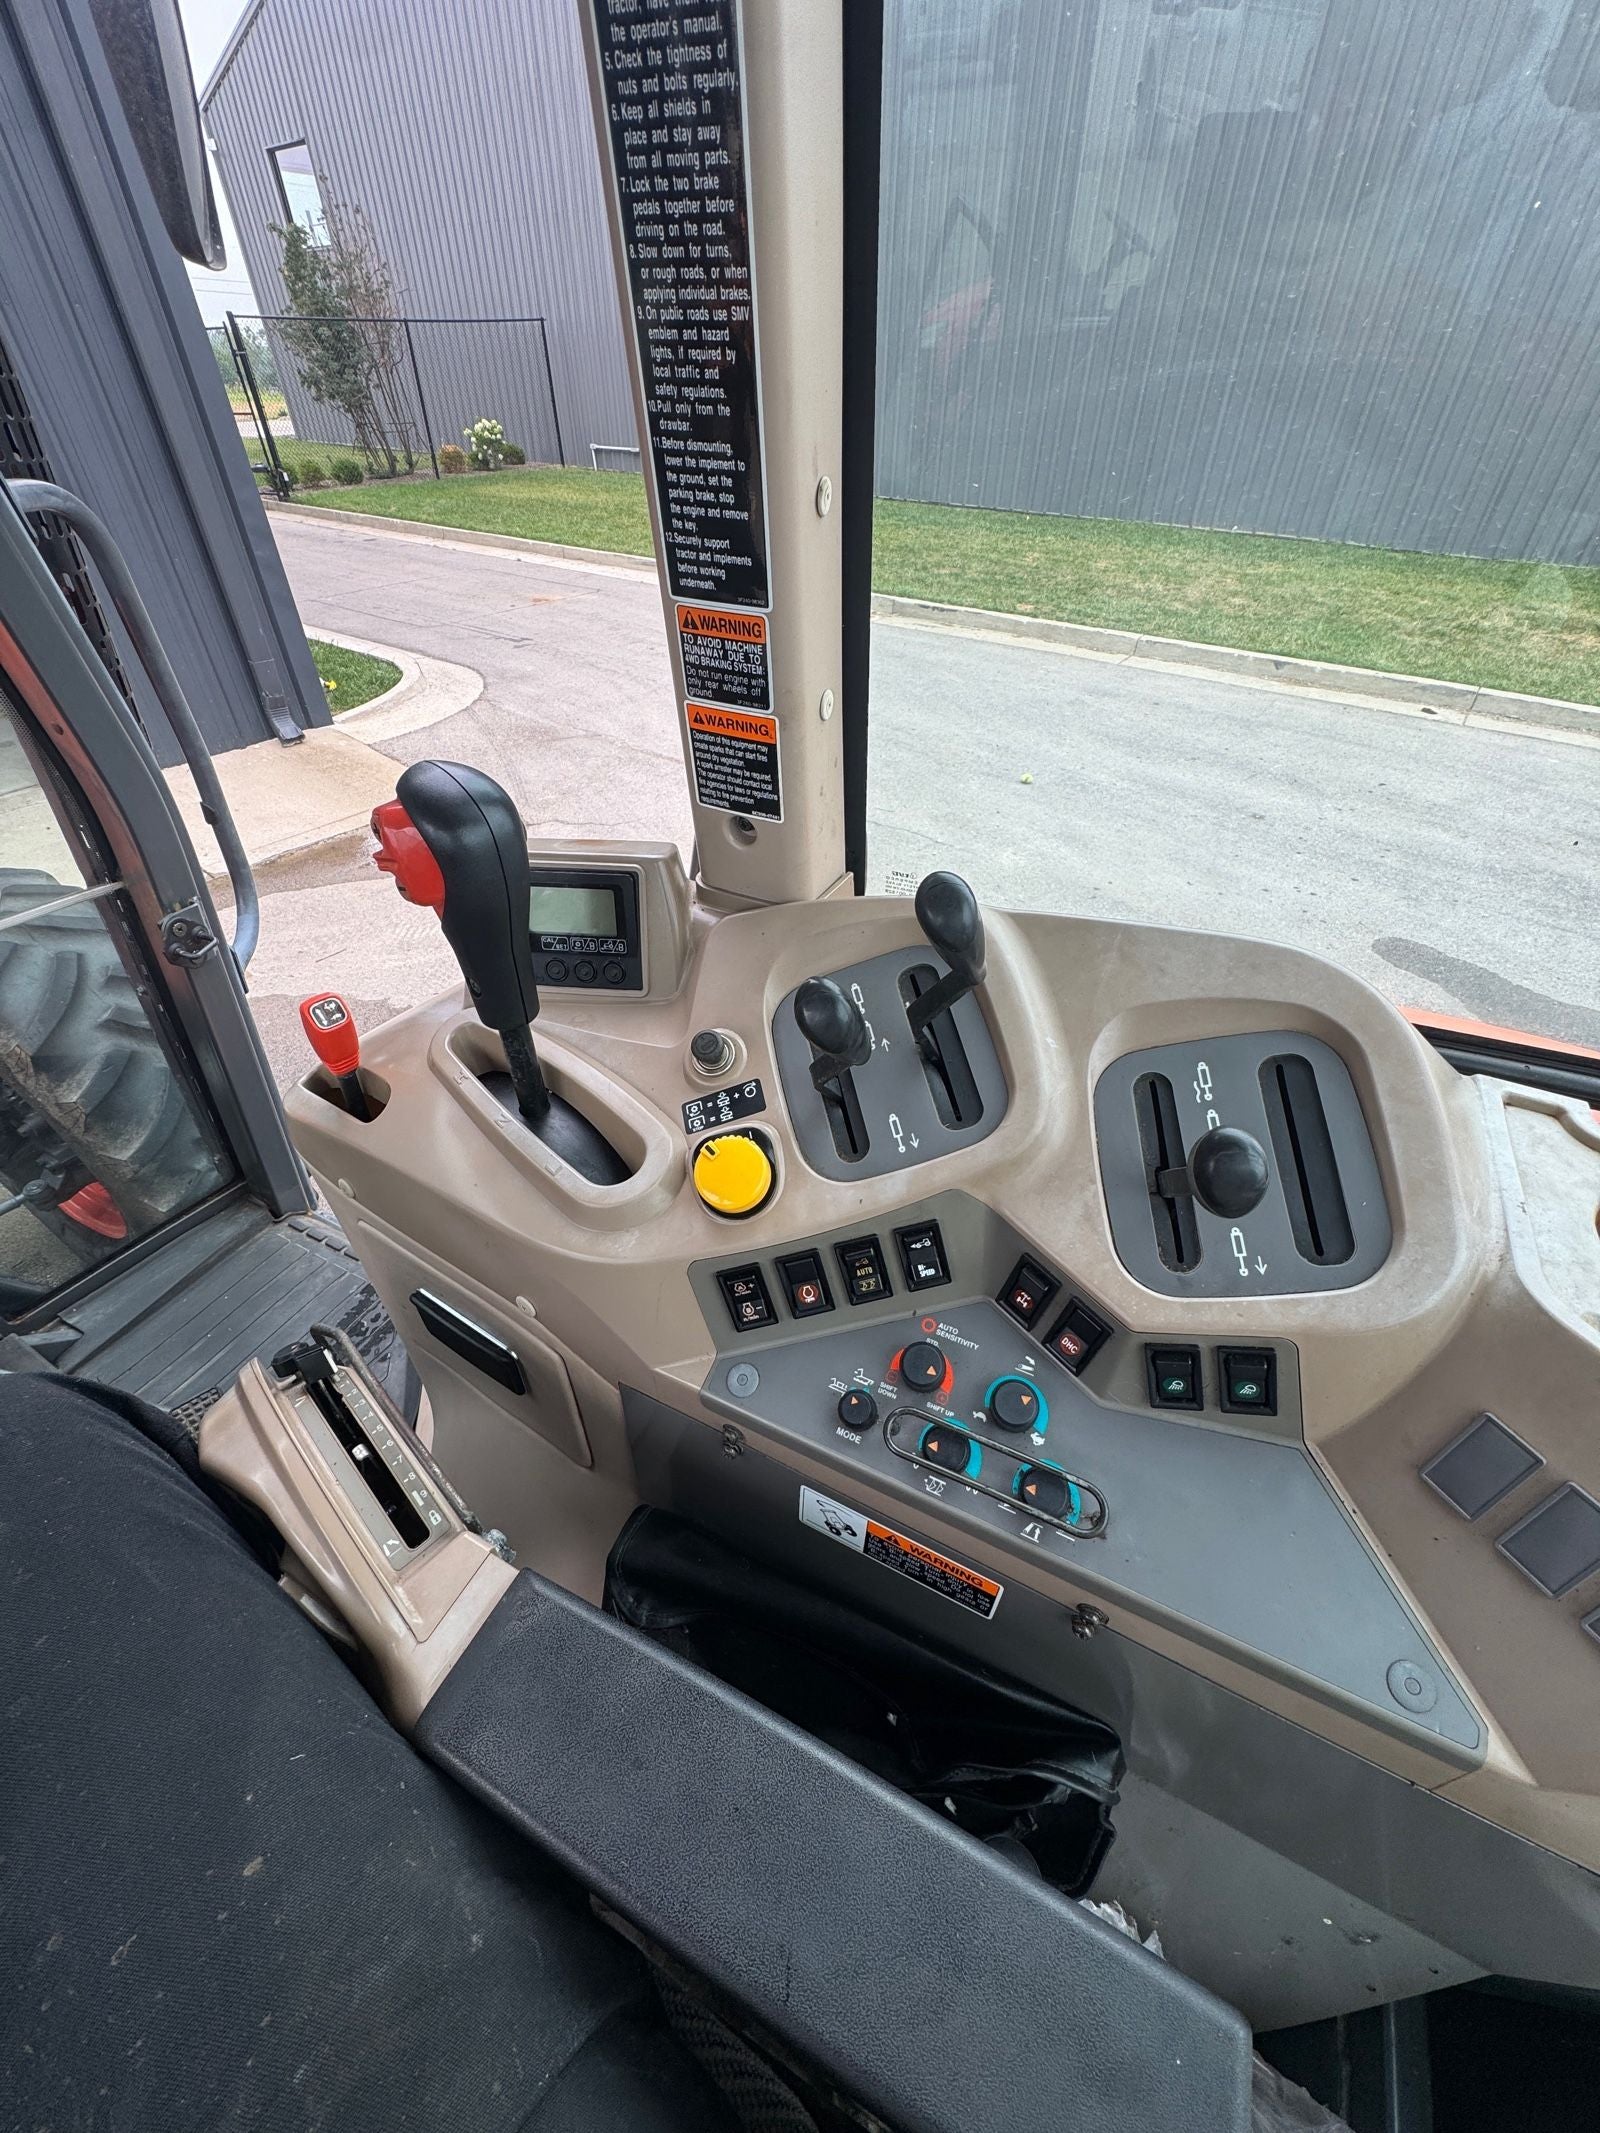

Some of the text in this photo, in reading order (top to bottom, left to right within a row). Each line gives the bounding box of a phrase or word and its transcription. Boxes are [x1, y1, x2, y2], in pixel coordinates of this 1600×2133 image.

[607, 0, 642, 14] tractor,
[611, 11, 722, 43] the operator's manual.
[615, 47, 642, 69] Check
[647, 47, 662, 66] the
[667, 43, 711, 67] tightness
[717, 39, 727, 59] of
[617, 67, 738, 96] nuts and bolts regularly.
[620, 102, 643, 122] Keep
[648, 100, 658, 118] all
[664, 98, 696, 117] shields
[702, 96, 711, 114] in
[624, 125, 720, 149] place and stay away
[627, 149, 731, 170] from all moving parts.
[630, 174, 650, 192] Lock
[654, 174, 668, 191] the
[673, 175, 689, 190] two
[694, 173, 719, 190] brake
[633, 197, 734, 218] pedals together before
[636, 221, 725, 240] driving on the road.
[638, 243, 657, 259] Slow
[662, 244, 684, 258] down
[689, 244, 701, 258] for
[706, 244, 732, 259] turns,
[641, 265, 747, 283] or rough roads, or when
[644, 285, 750, 304] applying individual brakes.
[646, 305, 657, 320] On
[660, 306, 683, 323] public
[687, 306, 709, 320] roads
[713, 308, 727, 320] use
[731, 306, 750, 321] SMV
[649, 326, 729, 341] emblem and hazard
[650, 346, 736, 365] lights, if required by
[653, 365, 719, 379] local traffic and
[655, 384, 727, 401] safety regulations.
[676, 401, 691, 416] only
[696, 401, 713, 415] from
[718, 402, 730, 416] the
[660, 417, 692, 432] drawbar.
[687, 439, 733, 456] dismounting,
[664, 454, 745, 473] lower the implement to
[666, 471, 732, 487] the ground, set the
[669, 488, 735, 505] parking brake, stop
[670, 503, 748, 520] the engine and remove
[672, 518, 698, 532] the key.
[704, 538, 730, 549] support
[676, 548, 752, 566] tractor and implements
[678, 562, 725, 580] before working
[679, 577, 716, 590] underneath.
[698, 614, 762, 638] WARNING
[683, 633, 763, 655] TO AVOID MACHINE
[684, 644, 761, 665] RUNAWAY DUE TO
[685, 654, 765, 675] 4WD BRAKING SYSTEM:
[686, 665, 766, 687] Do not run engine with
[688, 678, 761, 697] only rear wheels off
[704, 713, 770, 736] WARNING
[856, 1266, 873, 1277] AUTO
[938, 1323, 958, 1334] AUTO
[936, 1329, 979, 1350] SENSITIVITY
[1062, 1336, 1078, 1354] DHC
[878, 1388, 897, 1399] DOWN
[880, 1381, 897, 1392] SHIFT
[926, 1402, 945, 1413] SHIFT
[835, 1427, 862, 1445] MODE
[397, 1455, 402, 1463] 7
[408, 1472, 416, 1480] 8
[909, 1544, 983, 1587] WARNING
